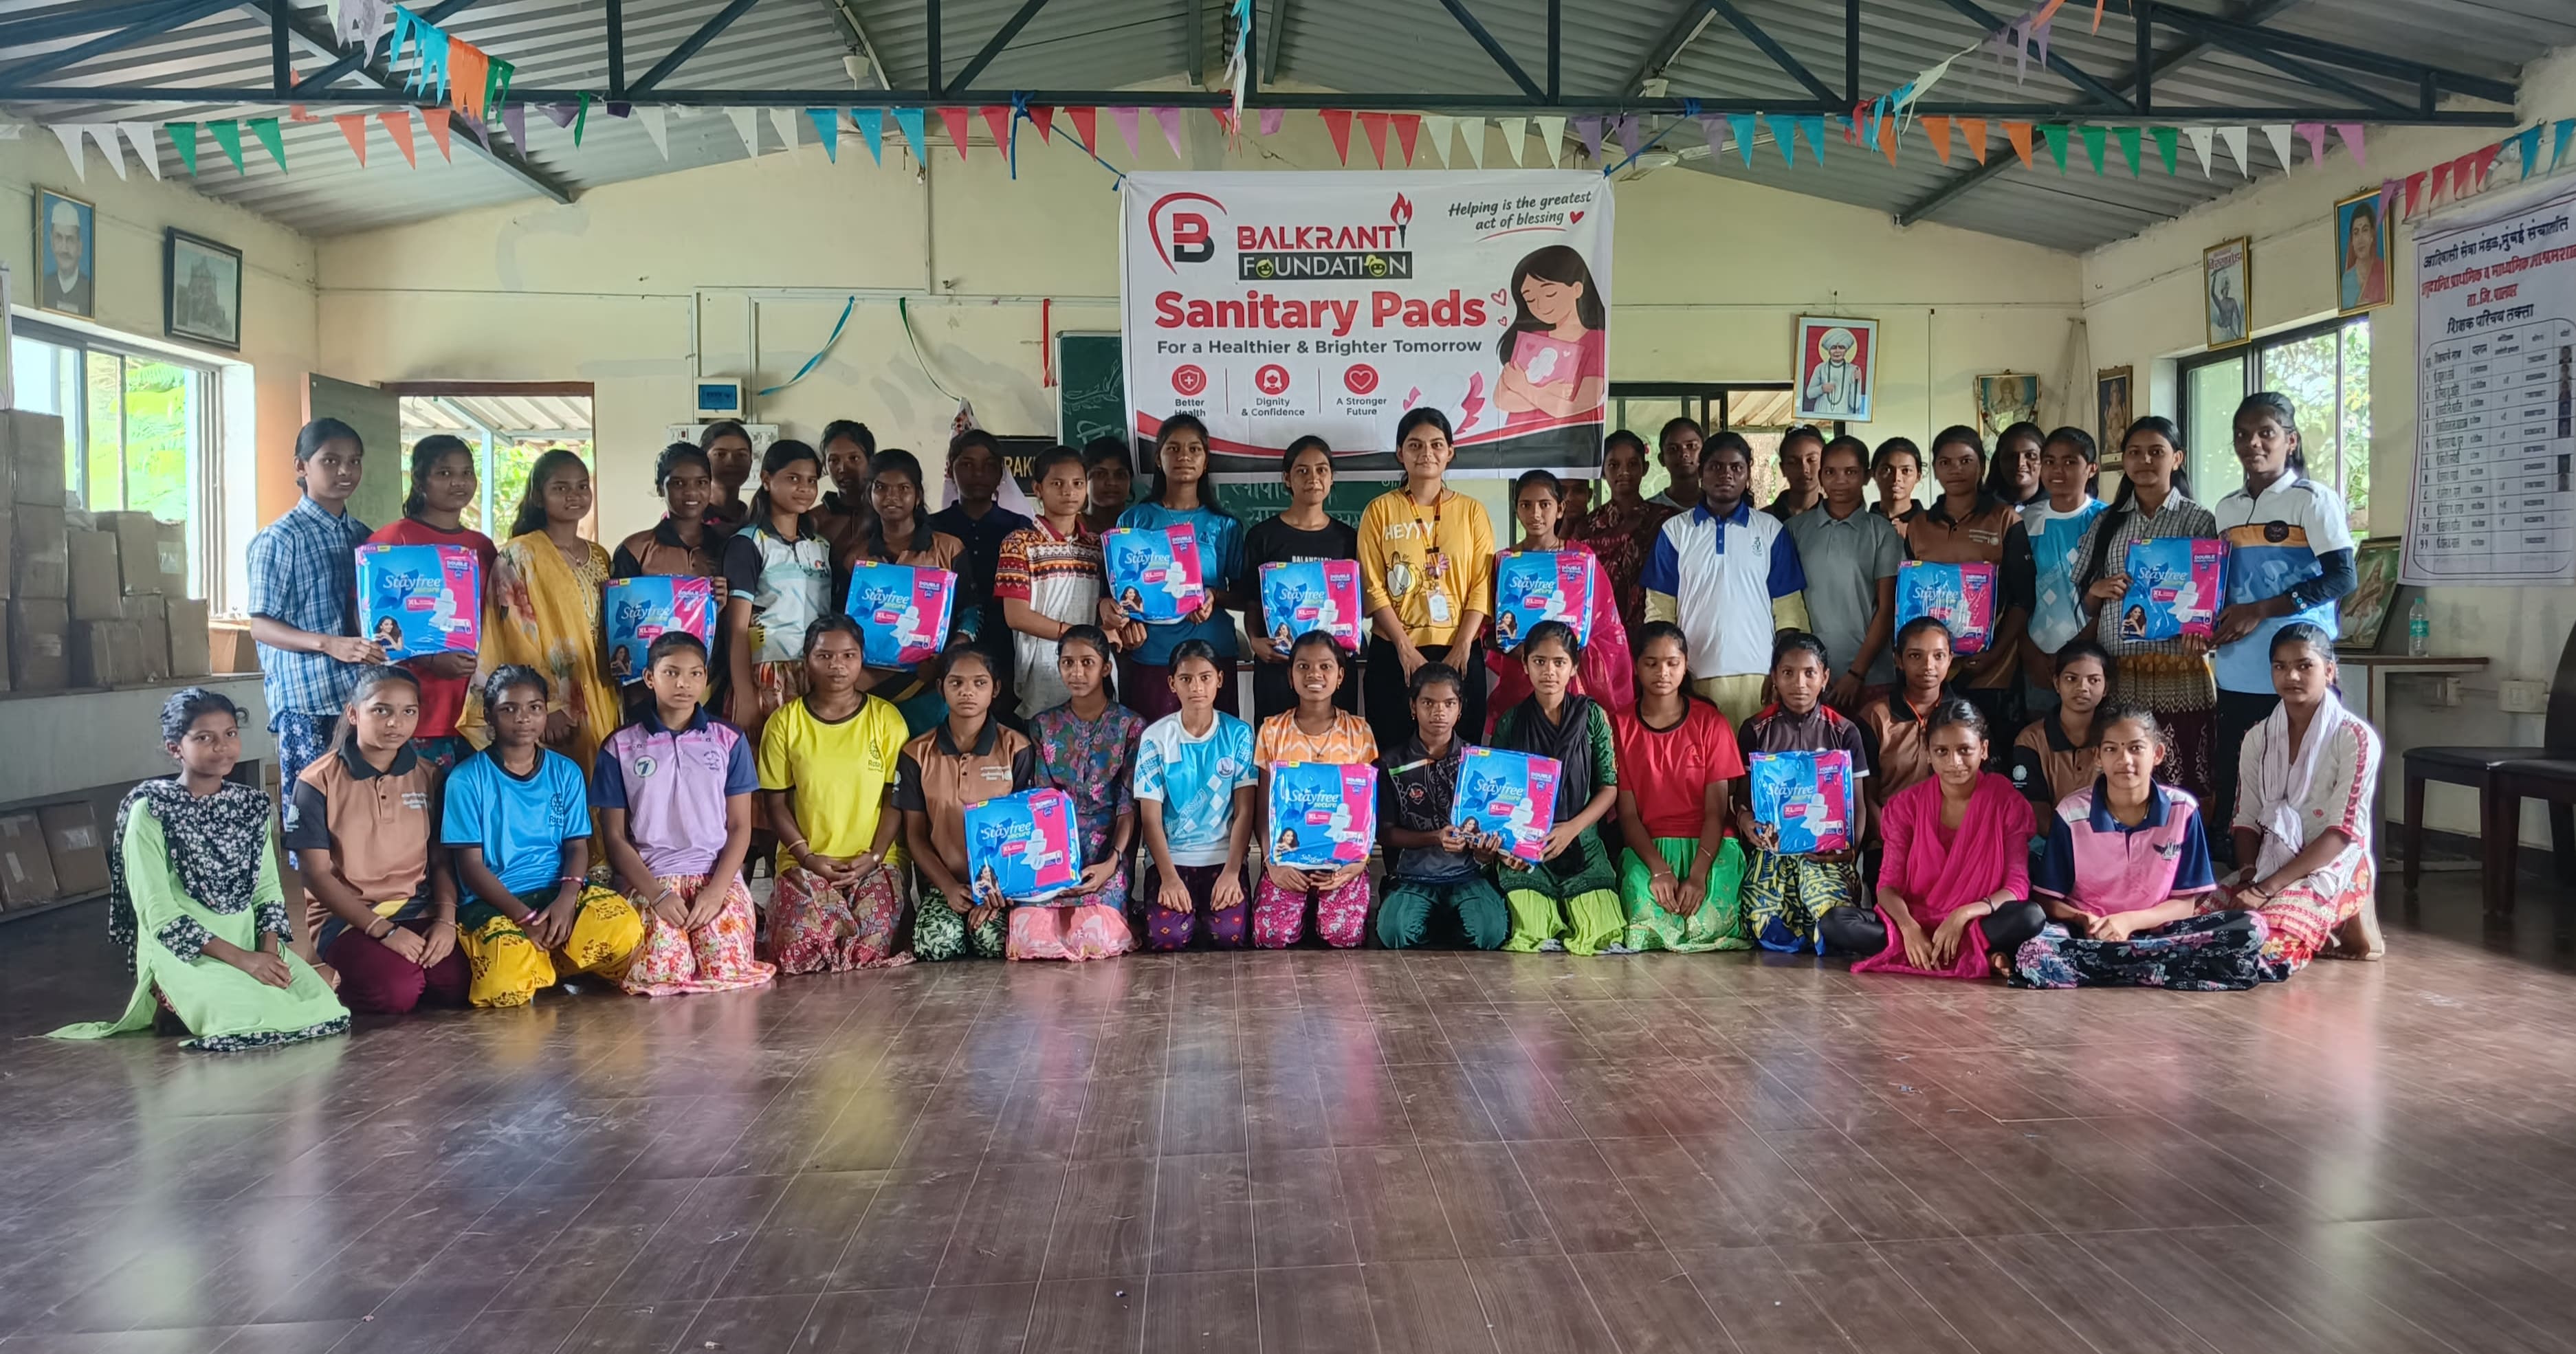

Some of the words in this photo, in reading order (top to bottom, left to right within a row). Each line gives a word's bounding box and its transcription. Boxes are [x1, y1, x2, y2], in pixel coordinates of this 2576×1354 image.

[1448, 201, 1499, 218] Helping
[1502, 199, 1512, 211] is
[1516, 196, 1536, 209] the
[1540, 191, 1592, 210] greatest
[1475, 217, 1496, 230] act
[1500, 214, 1515, 229] of
[1517, 212, 1564, 225] blessing
[1243, 255, 1407, 277] FOUNDATION
[1155, 290, 1358, 337] Sanitary
[1372, 289, 1486, 328] Pads
[1158, 340, 1186, 354] For
[1192, 344, 1202, 354] a
[1209, 340, 1290, 354] Healthier
[1297, 340, 1309, 353] &
[1316, 339, 1387, 357] Brighter
[1393, 339, 1482, 353] Tomorrow
[1175, 399, 1204, 407] Better
[1256, 397, 1290, 407] Dignity
[1345, 397, 1387, 406] Stronger
[1251, 408, 1305, 416] Confidence
[1125, 553, 1171, 566] Stayfree
[2137, 567, 2188, 581] Stayfree
[383, 573, 441, 592] Stayfree
[1509, 576, 1556, 590] Stayfree
[861, 588, 910, 606] Stayfree
[1279, 588, 1325, 601] Stayfree
[621, 606, 672, 620] Stayfree
[637, 759, 650, 775] 7
[1474, 778, 1523, 795] Stayfree
[1766, 782, 1814, 798] Stayfree
[1289, 790, 1339, 805] Stayfree
[982, 822, 1031, 840] Stayfree
